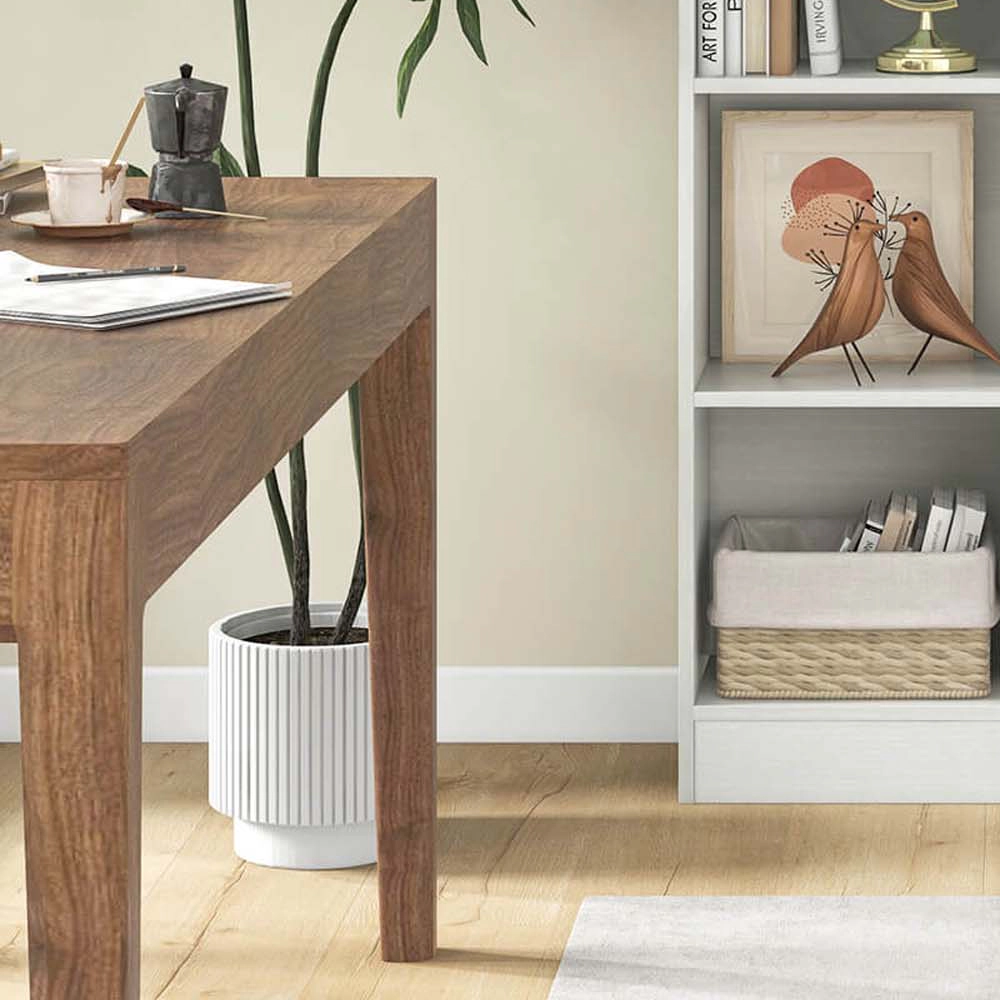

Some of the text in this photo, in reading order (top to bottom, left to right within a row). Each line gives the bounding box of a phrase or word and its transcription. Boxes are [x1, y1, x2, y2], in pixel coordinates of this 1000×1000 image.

[702, 1, 717, 30] FOR
[813, 0, 827, 43] IRVING
[702, 36, 717, 62] ART
